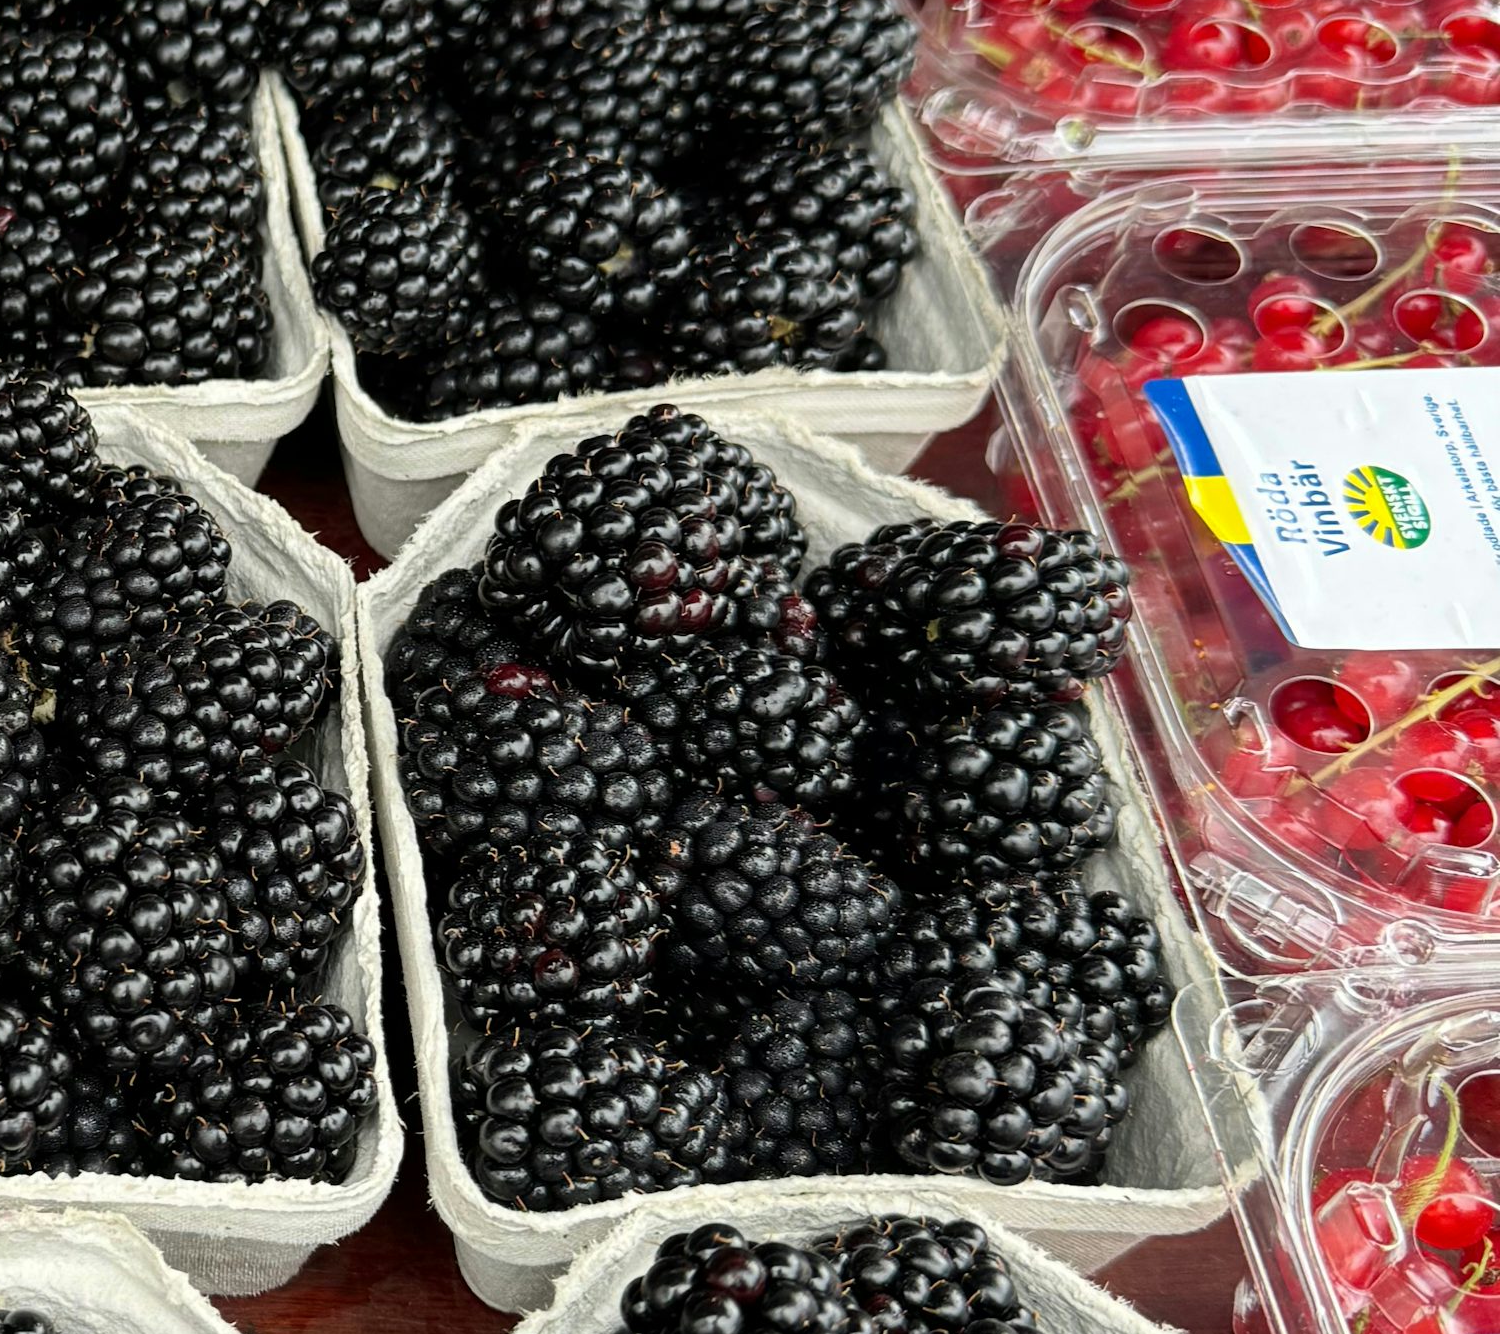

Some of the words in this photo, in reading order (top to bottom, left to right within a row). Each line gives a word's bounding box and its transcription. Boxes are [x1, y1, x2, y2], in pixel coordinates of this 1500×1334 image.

[1423, 392, 1450, 438] Sverige.
[1476, 460, 1500, 493] bästa
[1257, 473, 1308, 544] Röda
[1289, 460, 1351, 557] Vinbär
[1376, 474, 1419, 540] SVENSKT
[1399, 482, 1429, 530] SIGILL
